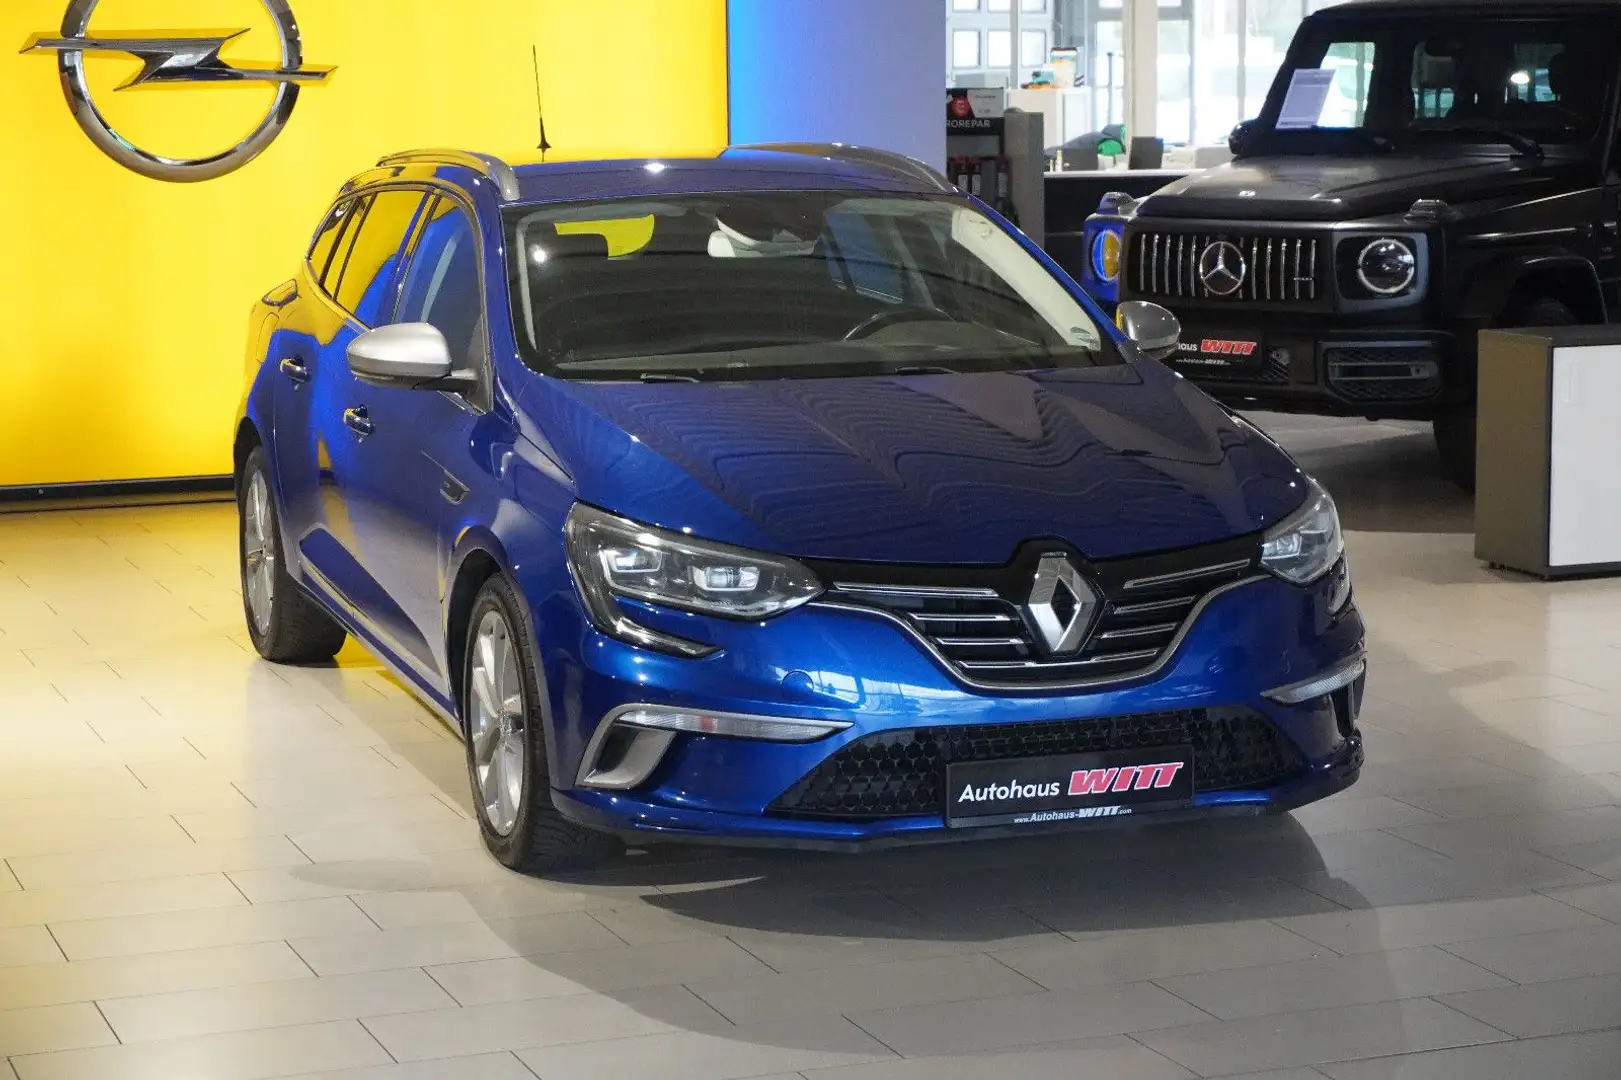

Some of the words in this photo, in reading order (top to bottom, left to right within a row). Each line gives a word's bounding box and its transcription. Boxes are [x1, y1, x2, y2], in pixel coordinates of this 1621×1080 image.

[1200, 339, 1257, 355] WITT
[959, 780, 1060, 802] Autohaus
[1068, 762, 1184, 795] WITT
